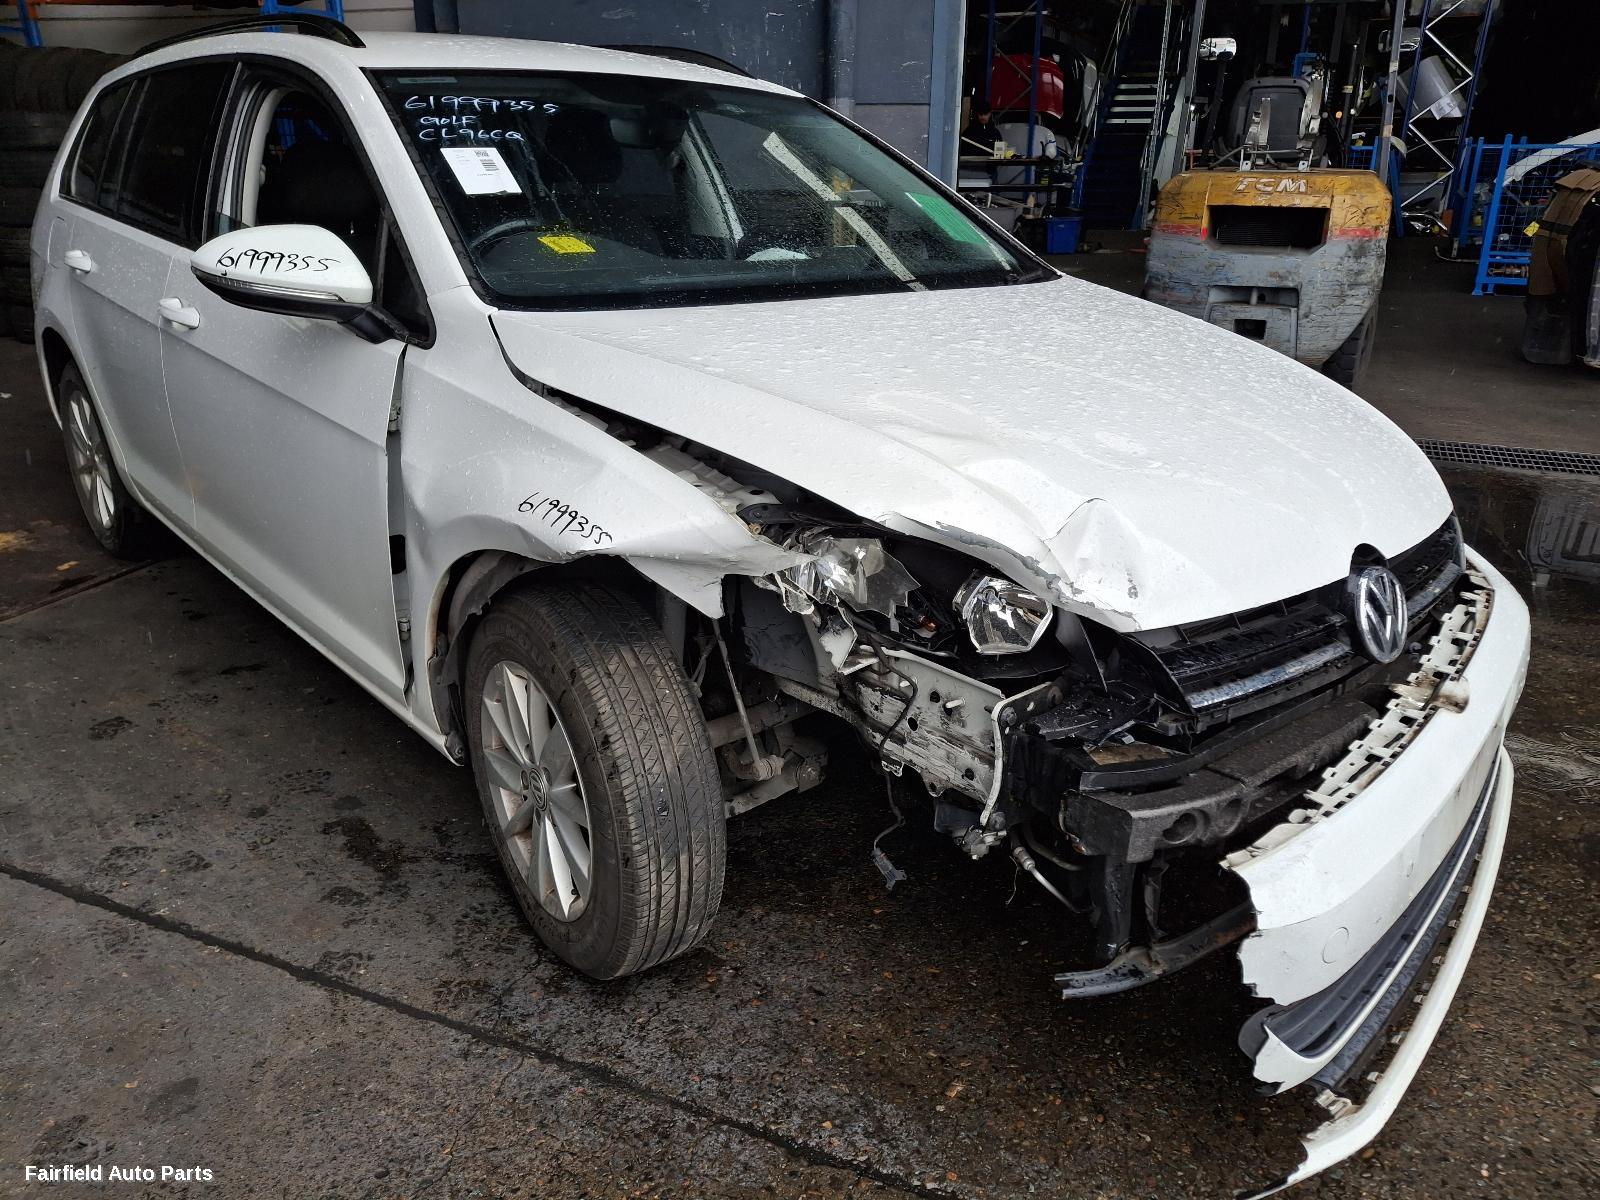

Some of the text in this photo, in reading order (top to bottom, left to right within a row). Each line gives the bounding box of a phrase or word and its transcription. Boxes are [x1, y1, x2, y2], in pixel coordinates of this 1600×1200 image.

[1234, 176, 1309, 193] TCM
[215, 247, 341, 275] 61999355
[517, 491, 613, 545] 61999355
